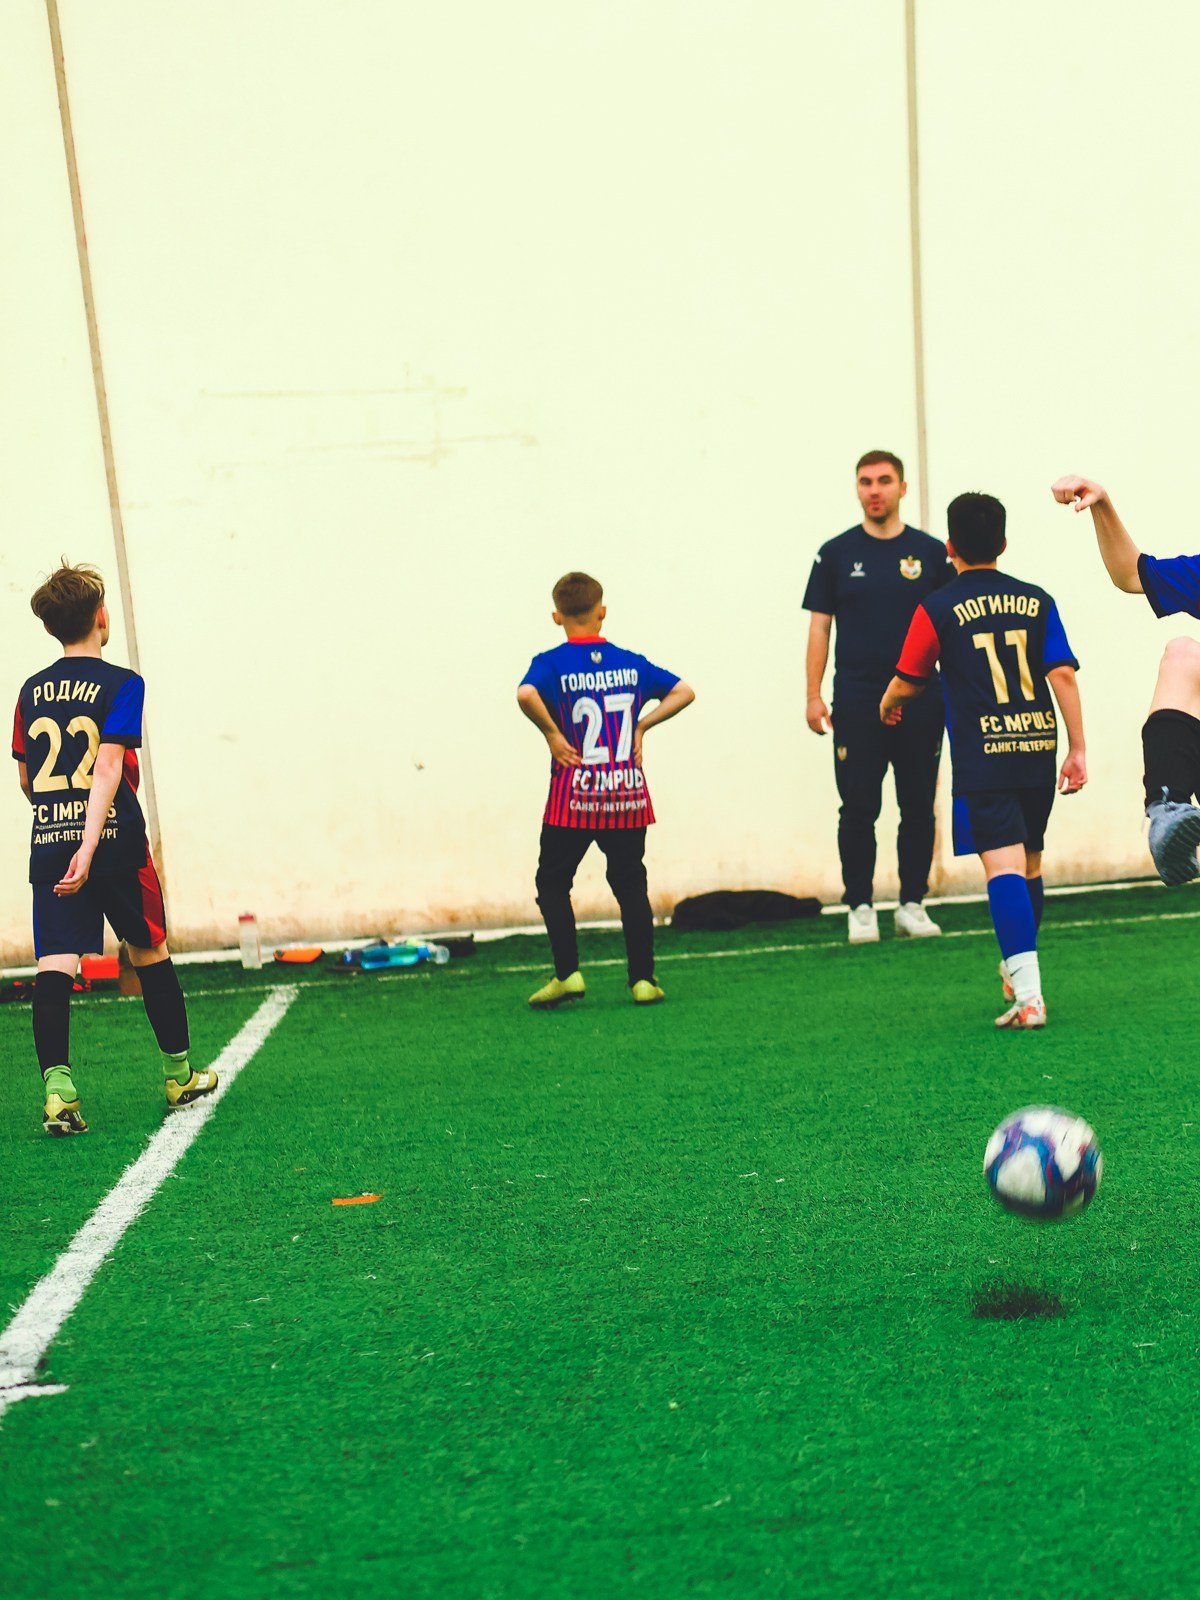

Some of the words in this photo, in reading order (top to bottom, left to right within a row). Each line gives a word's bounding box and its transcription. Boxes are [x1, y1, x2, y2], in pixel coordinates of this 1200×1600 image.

[953, 594, 1040, 626] ЛОГИНОВ
[972, 629, 1035, 704] 11
[33, 680, 101, 706] РОДИН
[560, 668, 638, 693] ГОЛОДЕНКО
[572, 693, 635, 765] 27
[980, 714, 1002, 733] FC
[27, 715, 101, 793] 22
[572, 768, 592, 791] FC
[53, 800, 117, 822] IMPS
[34, 827, 118, 845] АНКТ-ПЕТУРГ
